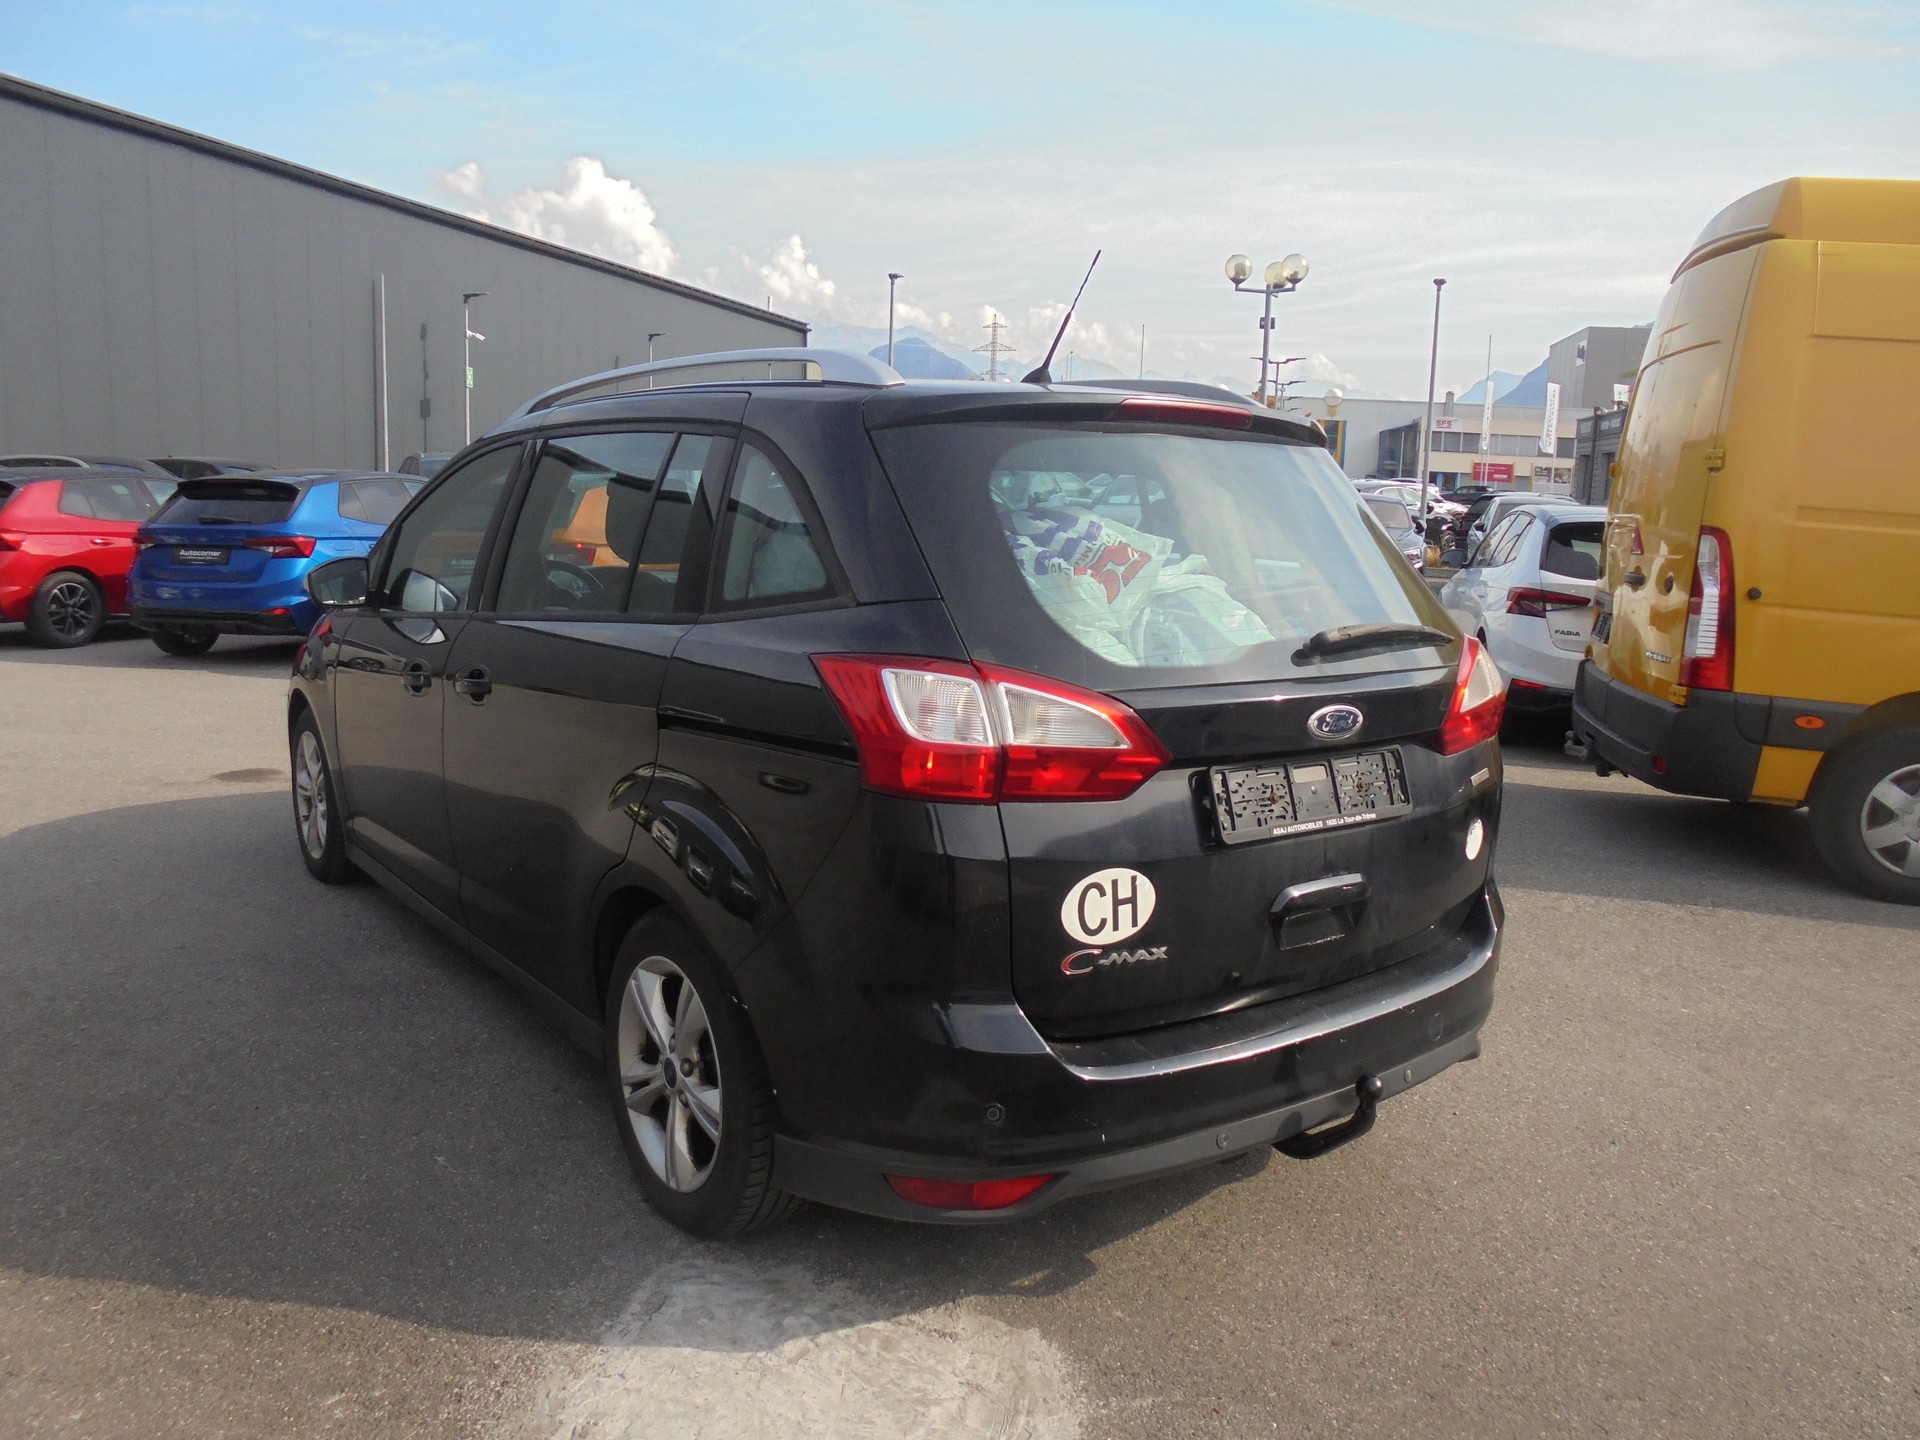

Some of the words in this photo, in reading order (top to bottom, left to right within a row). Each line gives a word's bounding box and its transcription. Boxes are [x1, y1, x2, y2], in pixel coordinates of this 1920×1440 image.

[179, 549, 221, 557] Autocorner
[1322, 711, 1354, 732] Ford
[1287, 821, 1323, 832] AUTOMOBILES
[1077, 874, 1139, 936] CH
